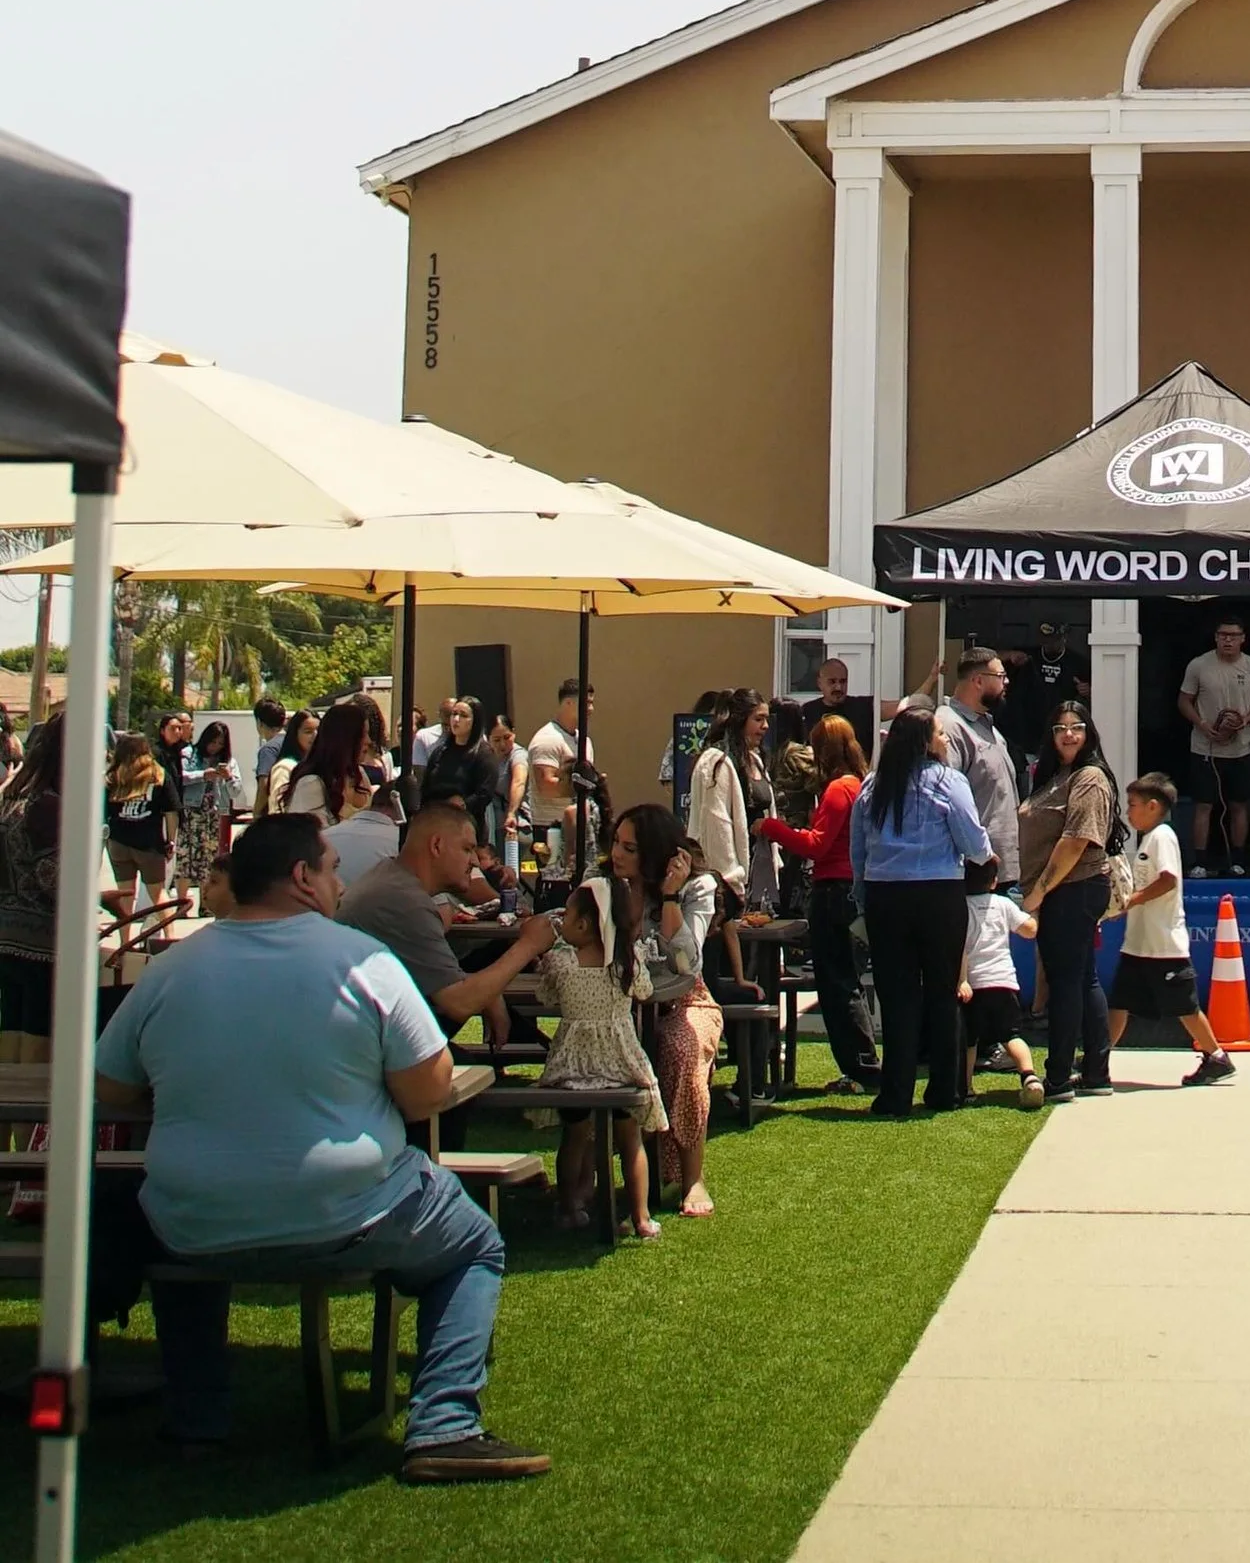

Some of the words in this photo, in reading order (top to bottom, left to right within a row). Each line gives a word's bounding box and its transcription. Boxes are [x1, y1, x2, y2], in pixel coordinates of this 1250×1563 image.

[425, 252, 440, 369] 15558
[911, 546, 1046, 582] LIVING
[1055, 550, 1188, 582] WORD
